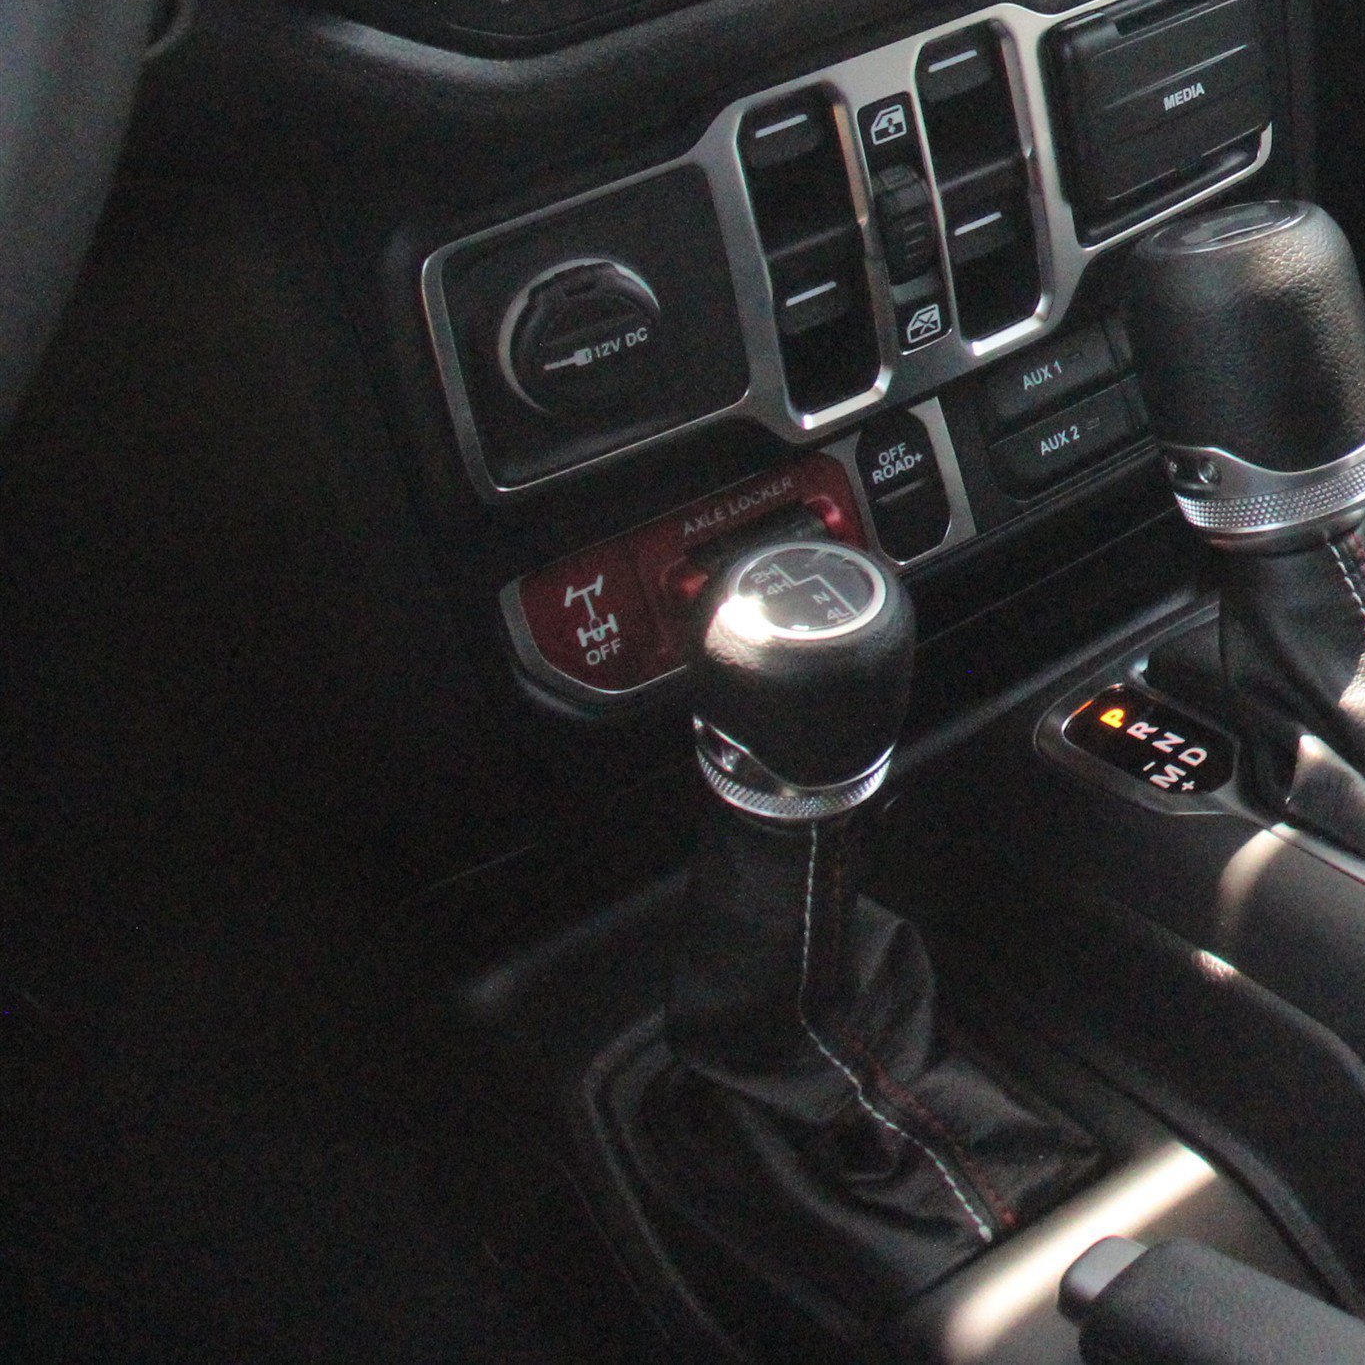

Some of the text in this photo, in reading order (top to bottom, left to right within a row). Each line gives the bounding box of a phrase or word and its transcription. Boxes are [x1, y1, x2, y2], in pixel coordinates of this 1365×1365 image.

[1163, 82, 1205, 111] MEDIA
[594, 327, 648, 358] 12V DC
[1022, 360, 1062, 390] AUX 1
[879, 442, 906, 466] OFF
[1040, 425, 1080, 455] AUX 2
[684, 476, 794, 537] AXLE LOCKER
[586, 638, 621, 665] OFF
[1100, 708, 1125, 728] P
[1126, 722, 1159, 740] R
[1178, 747, 1207, 766] D
